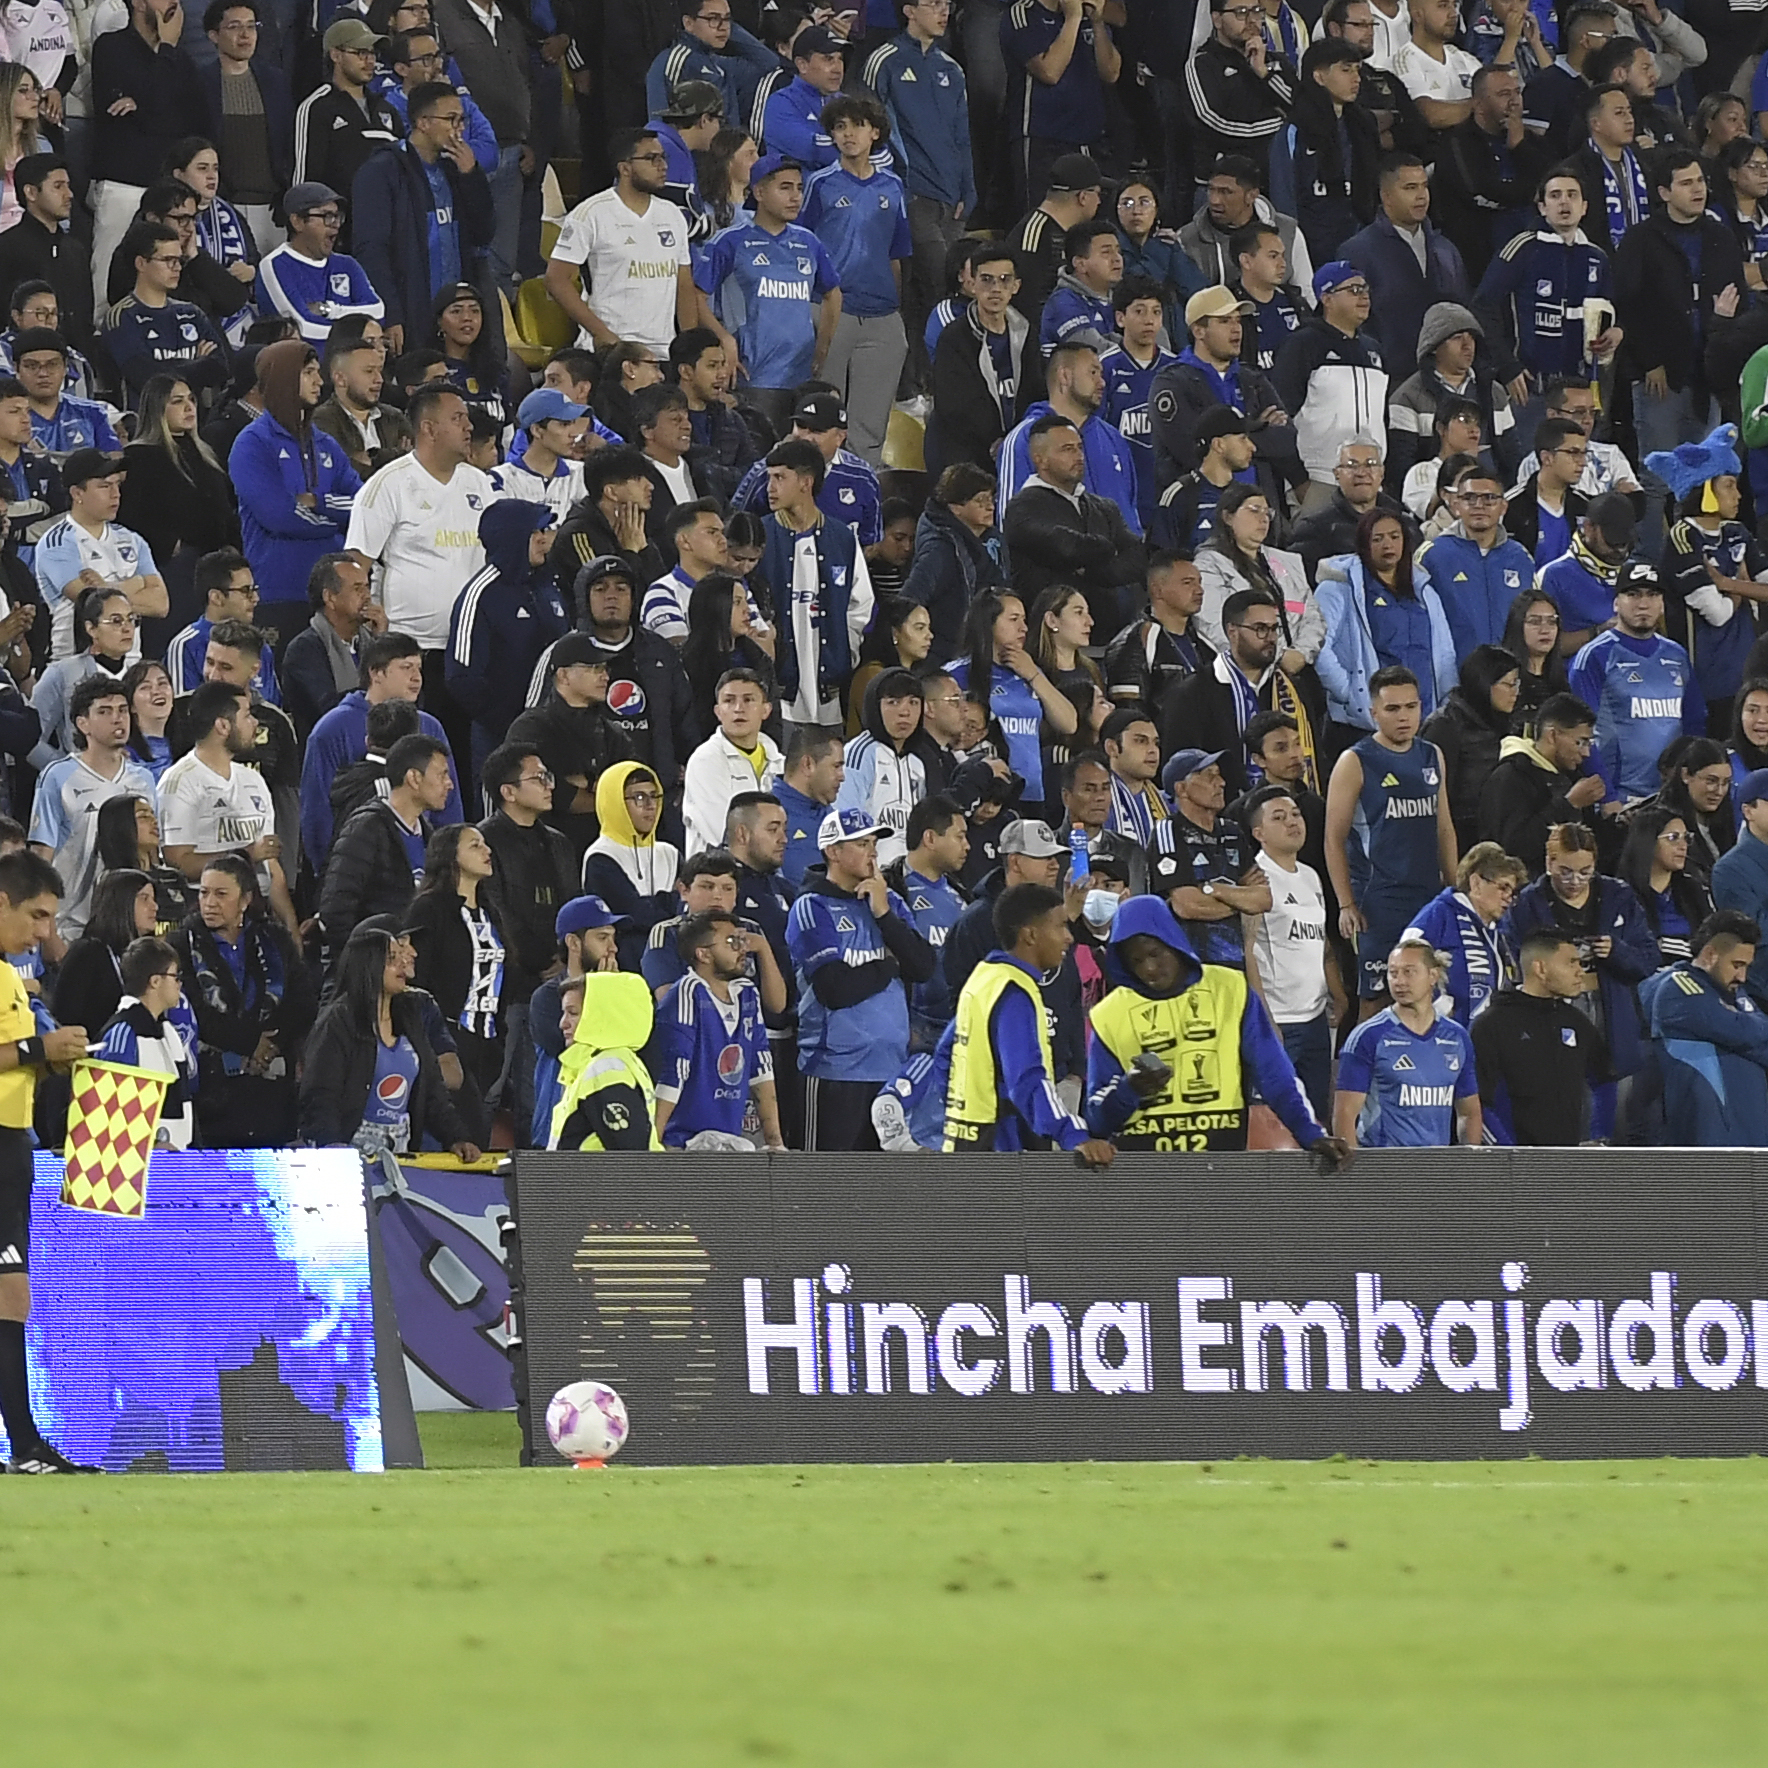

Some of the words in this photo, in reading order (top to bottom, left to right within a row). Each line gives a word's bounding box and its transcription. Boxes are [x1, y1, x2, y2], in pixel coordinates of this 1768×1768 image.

[30, 35, 65, 52] ANDINA
[628, 260, 677, 279] ANDINA
[757, 277, 809, 301] ANDINA
[1122, 411, 1152, 436] AND
[435, 529, 479, 547] ANDIN
[1632, 697, 1682, 719] ANDINA
[999, 717, 1037, 735] NDINA
[1386, 796, 1437, 820] ANDINA
[218, 816, 265, 843] ANDIN
[474, 950, 505, 963] EPS
[1400, 1084, 1454, 1106] ANDINA
[1123, 1117, 1160, 1136] ASA
[1163, 1113, 1240, 1135] PELOTAS
[744, 1264, 1153, 1395] Hincha
